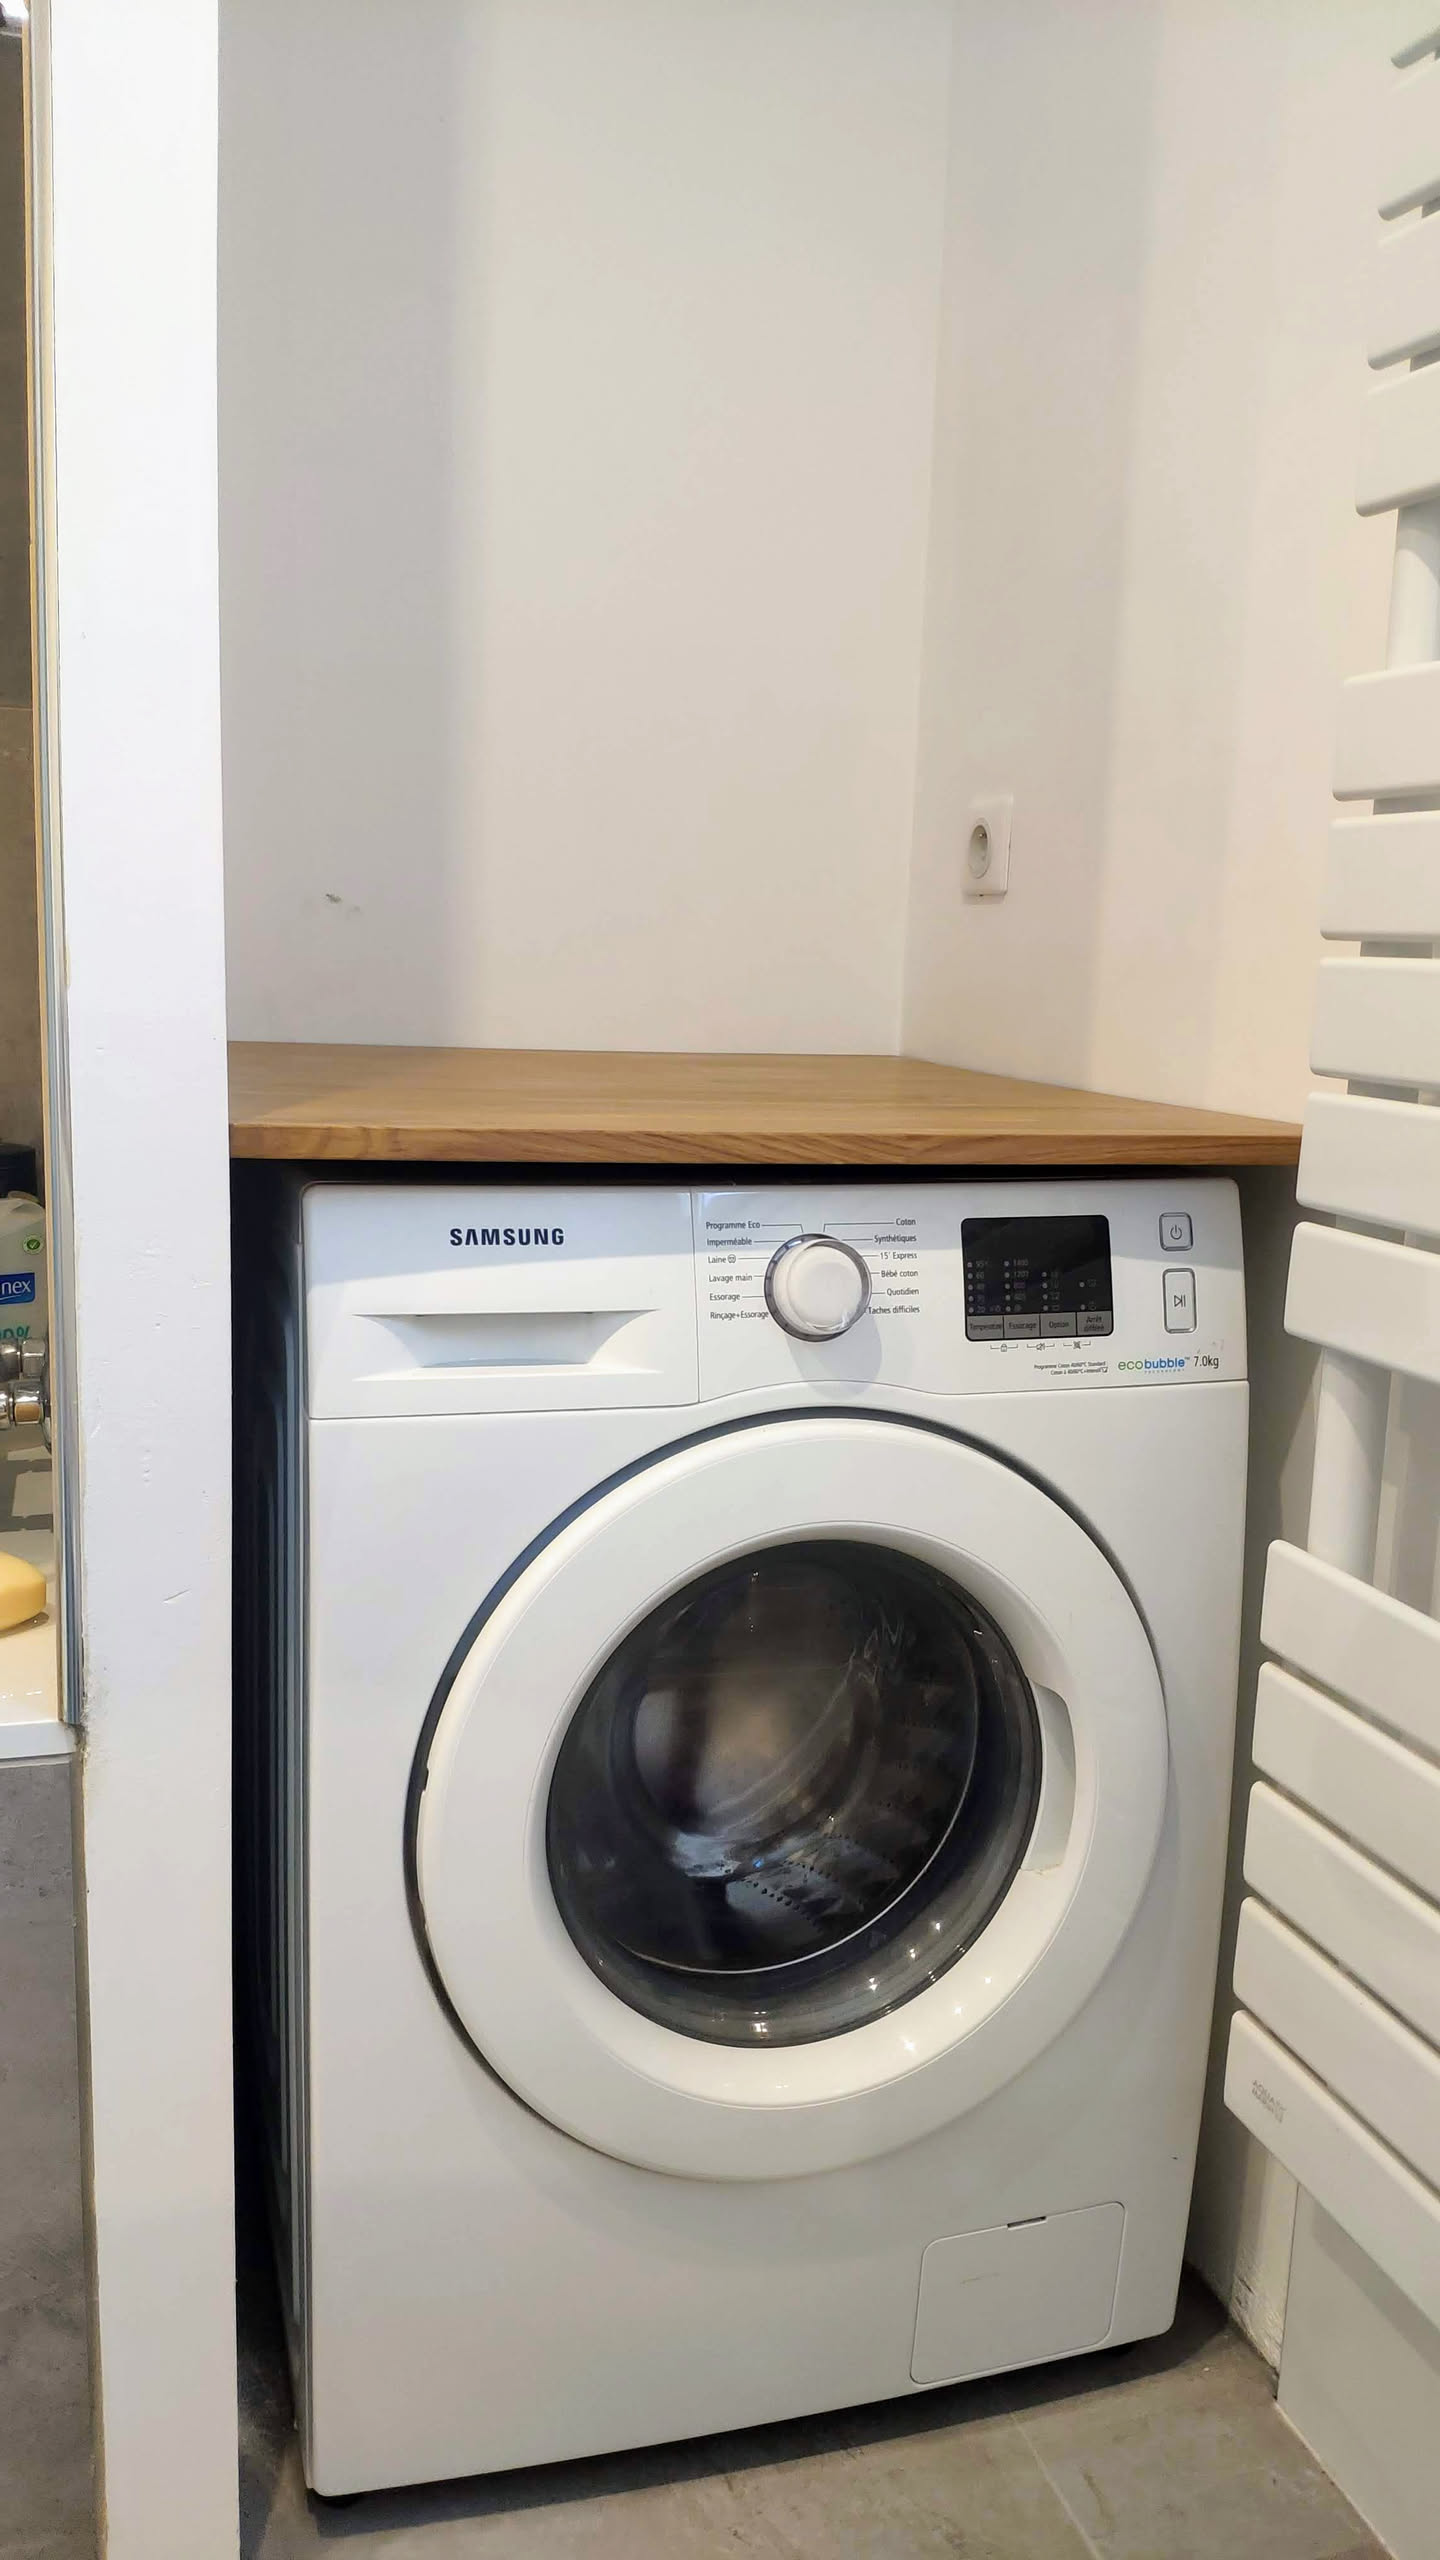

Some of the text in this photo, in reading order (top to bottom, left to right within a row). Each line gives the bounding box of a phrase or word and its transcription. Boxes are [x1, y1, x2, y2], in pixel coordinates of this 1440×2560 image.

[705, 1220, 761, 1231] Programme Eco
[895, 1217, 917, 1226] Coton
[450, 1228, 565, 1246] SAMSUNG
[706, 1237, 752, 1248] Imperméable
[874, 1234, 917, 1245] Synthétiques
[707, 1255, 727, 1264] Laine
[892, 1251, 918, 1261] Express
[708, 1273, 753, 1284] Lavage main
[899, 1270, 919, 1278] coton
[709, 1292, 741, 1303] Essorage
[886, 1287, 920, 1297] Quotidien
[868, 1305, 920, 1315] Taches difficiles
[1194, 1355, 1219, 1369] 7.0kg
